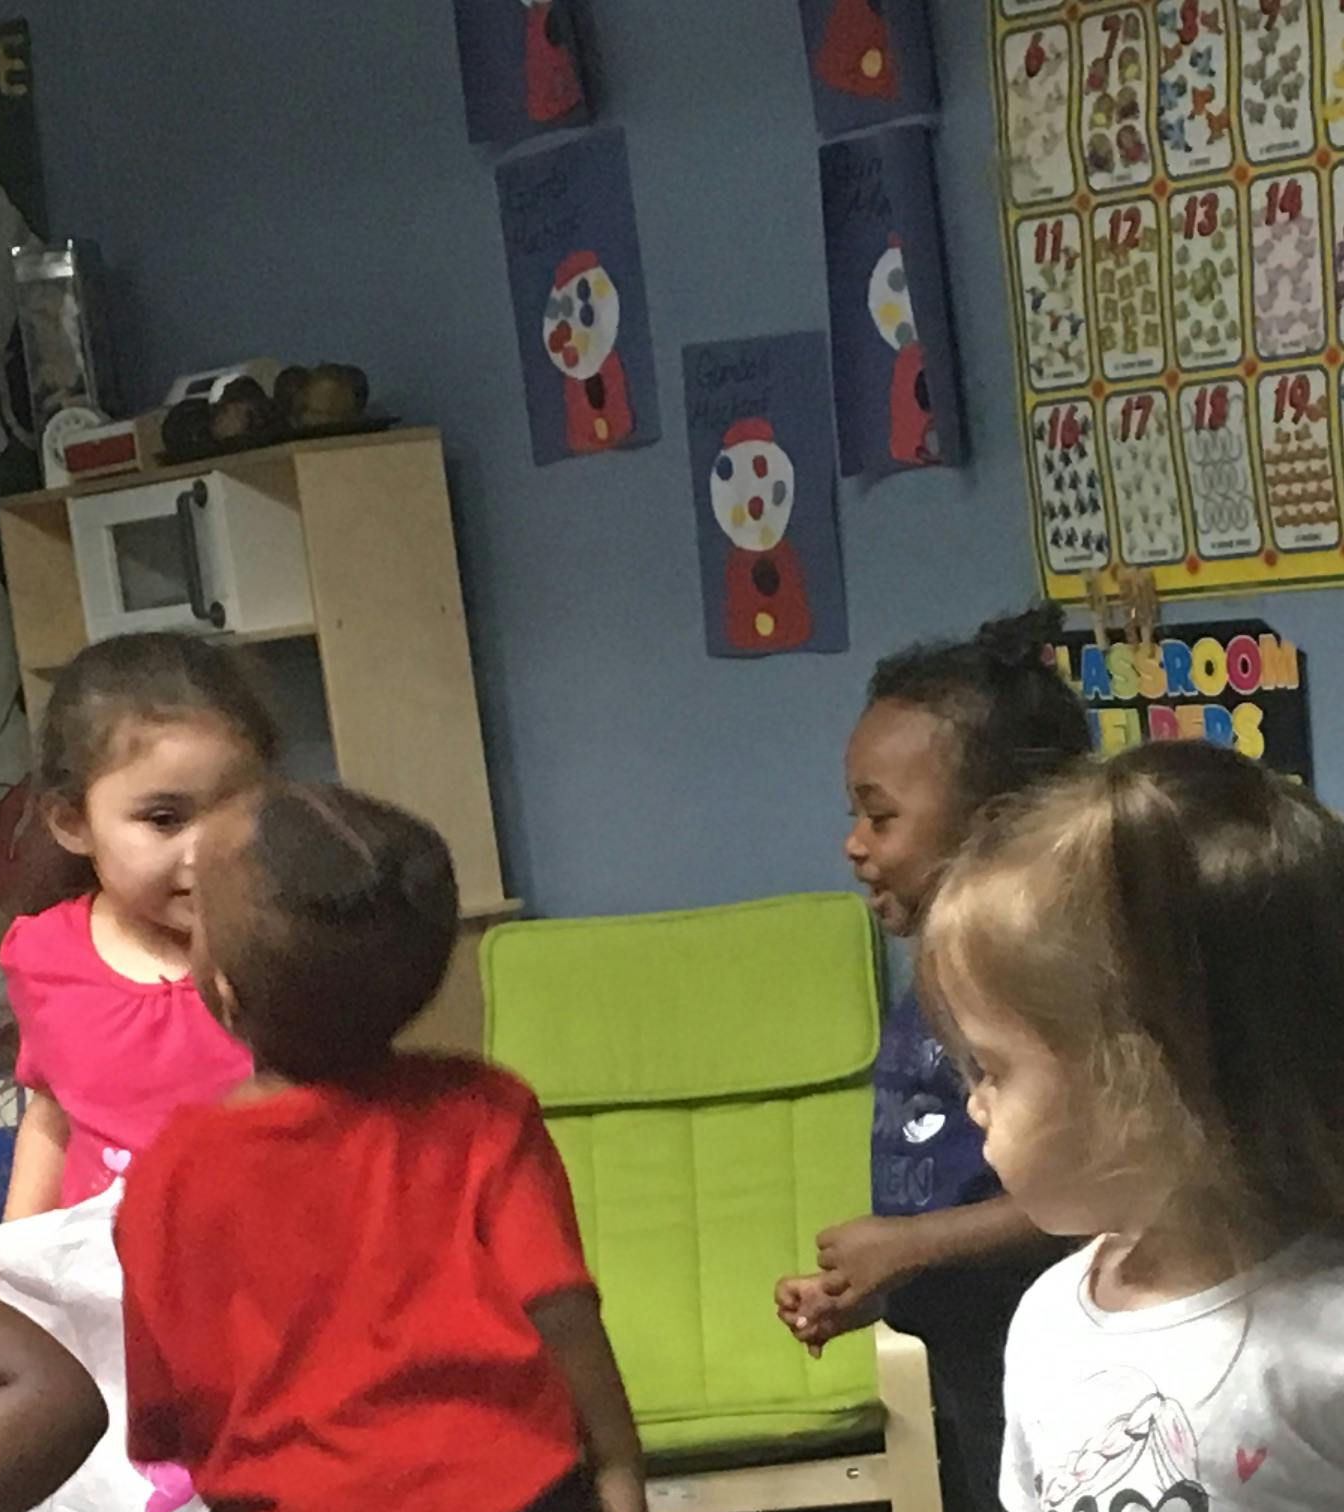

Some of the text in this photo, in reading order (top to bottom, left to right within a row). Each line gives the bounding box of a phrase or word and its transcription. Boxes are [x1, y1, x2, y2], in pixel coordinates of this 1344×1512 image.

[1033, 219, 1064, 264] 11
[1109, 205, 1142, 249] 12
[1183, 192, 1220, 240] 13
[1264, 177, 1303, 226] 14
[1047, 403, 1082, 450] 16
[1119, 394, 1155, 443] 17
[1193, 384, 1230, 434] 18
[1273, 373, 1311, 425] 19
[1041, 633, 1300, 700] LASSROOM
